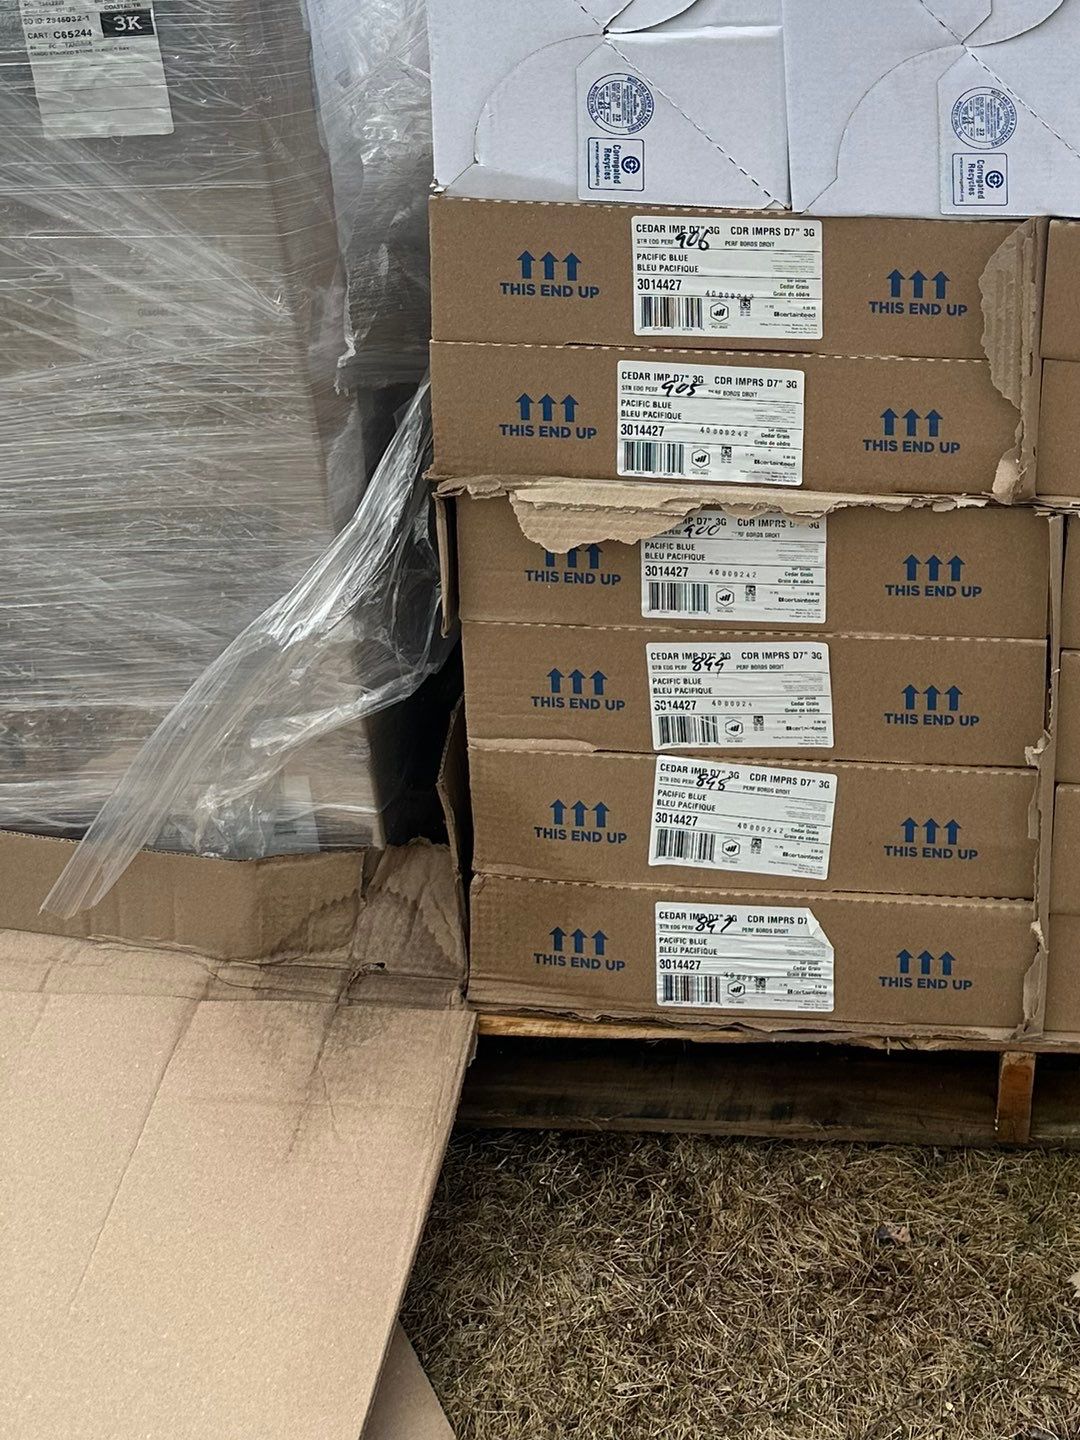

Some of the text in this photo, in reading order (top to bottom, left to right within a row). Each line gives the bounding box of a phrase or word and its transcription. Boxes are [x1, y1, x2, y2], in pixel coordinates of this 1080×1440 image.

[113, 16, 142, 31] 3K
[53, 29, 92, 39] C65244
[603, 147, 612, 181] Recycles
[613, 144, 622, 185] Corrugated
[967, 163, 976, 196] Recycles
[976, 159, 985, 200] Corrugated
[498, 424, 598, 440] THIS END UP
[883, 712, 980, 727] THIS END UP
[660, 763, 689, 774] CEDAR
[728, 770, 740, 780] 3G
[749, 772, 768, 782] CDR
[769, 774, 798, 786] IMPRS
[800, 777, 816, 787] D7"
[818, 779, 830, 789] 3G
[657, 789, 707, 801] PACIFIC BLUE
[656, 799, 716, 812] BLEU PACIFIQUE
[655, 812, 698, 827] 3014427
[533, 952, 626, 972] THIS END UP
